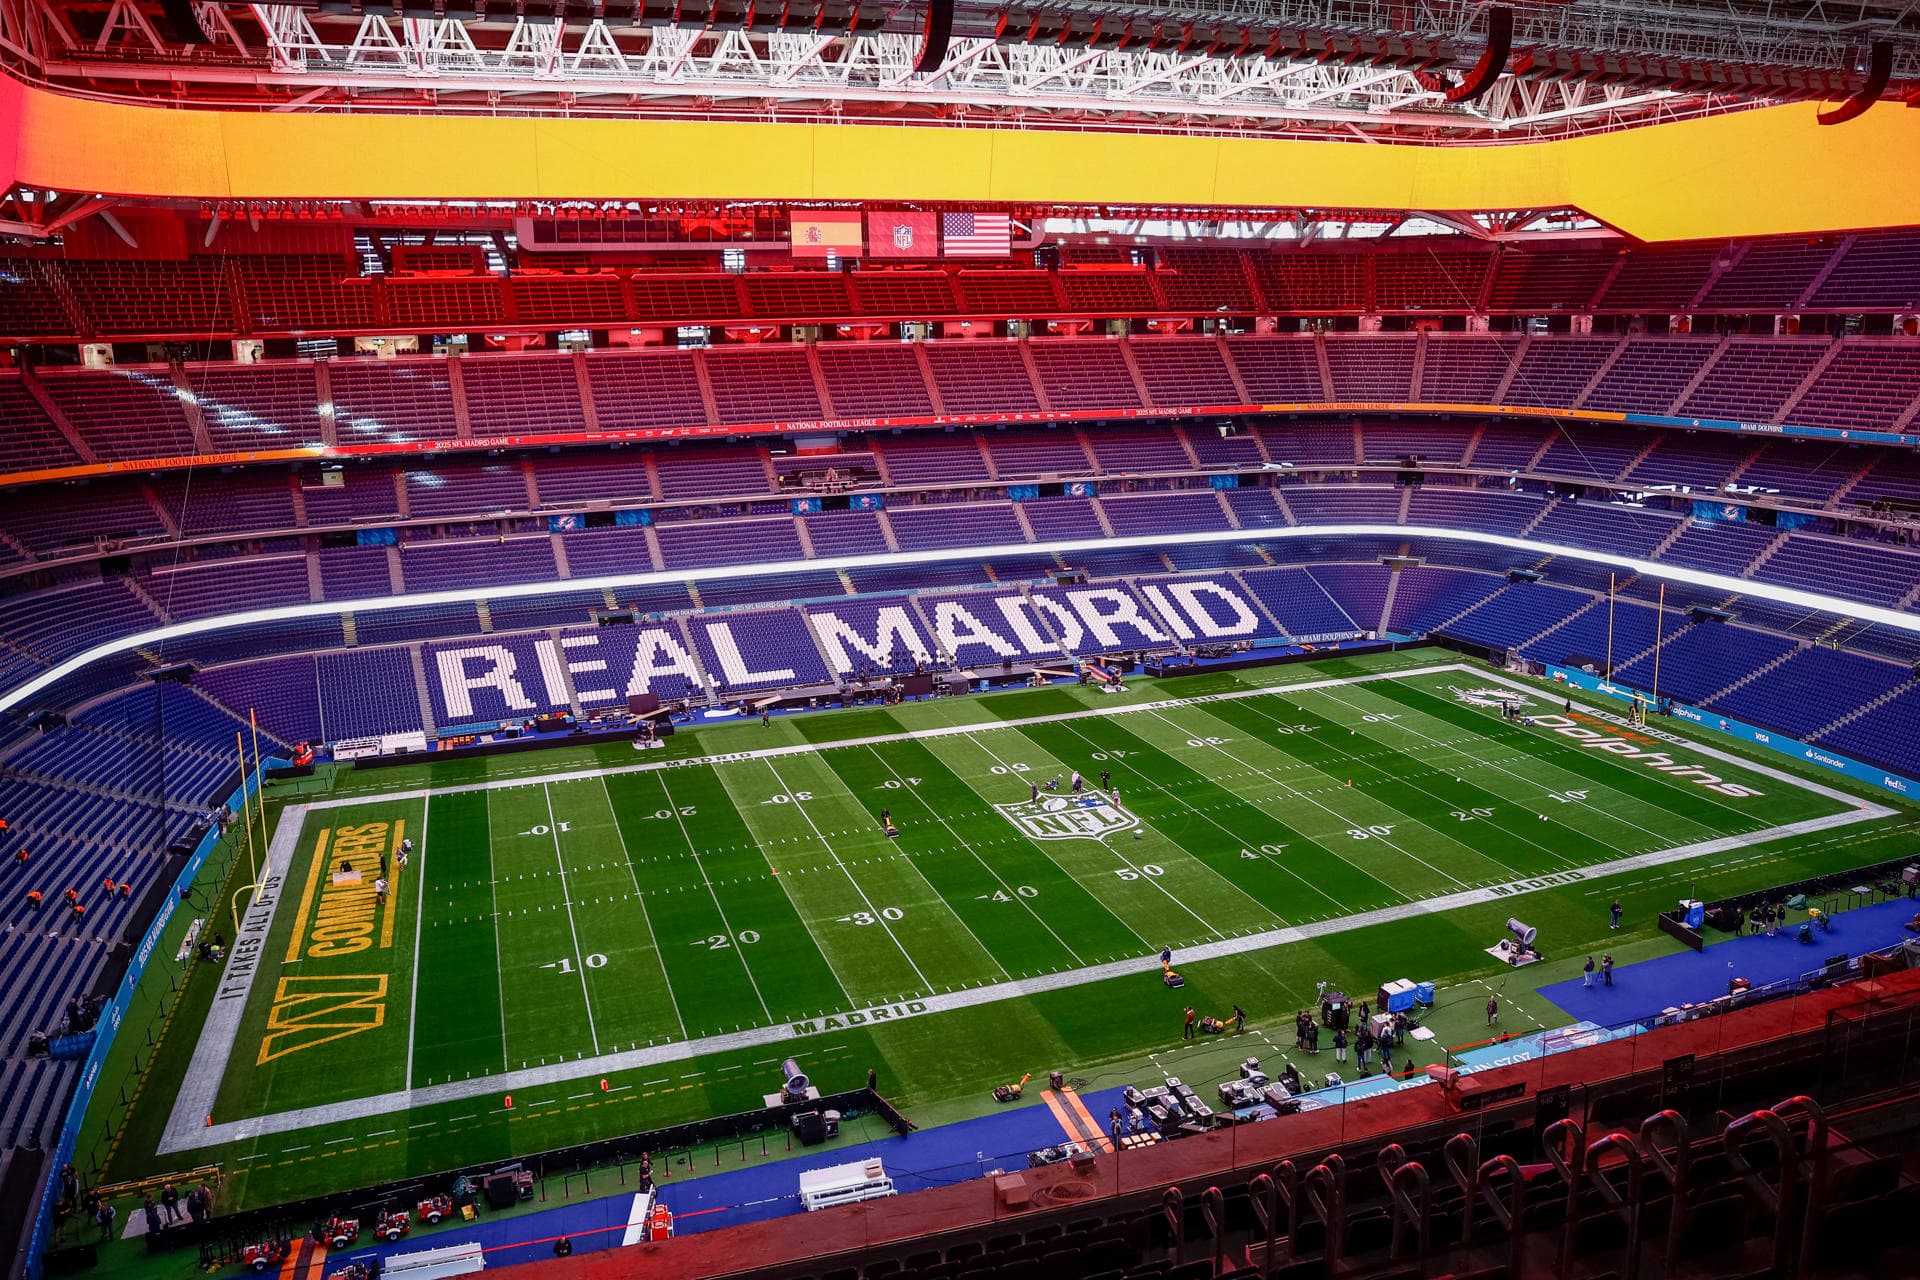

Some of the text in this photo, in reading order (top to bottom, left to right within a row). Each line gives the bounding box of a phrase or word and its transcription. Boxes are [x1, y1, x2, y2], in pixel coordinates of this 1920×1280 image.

[896, 234, 912, 248] NFL
[786, 418, 877, 430] NATIONAL FOOTBALL LEAGUE
[1740, 423, 1784, 433] MIAMI DOLPHINS
[434, 437, 509, 449] 2025 NFL MADRID GAME
[122, 453, 240, 469] NATIONAL FOOTBALL LEAGUE
[1300, 631, 1354, 643] MIAMI DOLPHINS
[435, 580, 1260, 719] REAL MADRID
[1148, 695, 1219, 708] MADRID
[1588, 709, 1620, 721] END
[1755, 731, 1770, 743] VISA
[665, 752, 751, 768] MADRID
[1526, 714, 1767, 799] Dolphins
[1813, 752, 1845, 769] Santander
[1884, 776, 1907, 792] FedEx
[1028, 805, 1126, 836] NFL
[1487, 870, 1587, 897] MADRID
[244, 911, 271, 932] ALL
[226, 938, 262, 981] TAKES
[219, 986, 246, 1000] IT
[791, 1001, 930, 1036] MADRID
